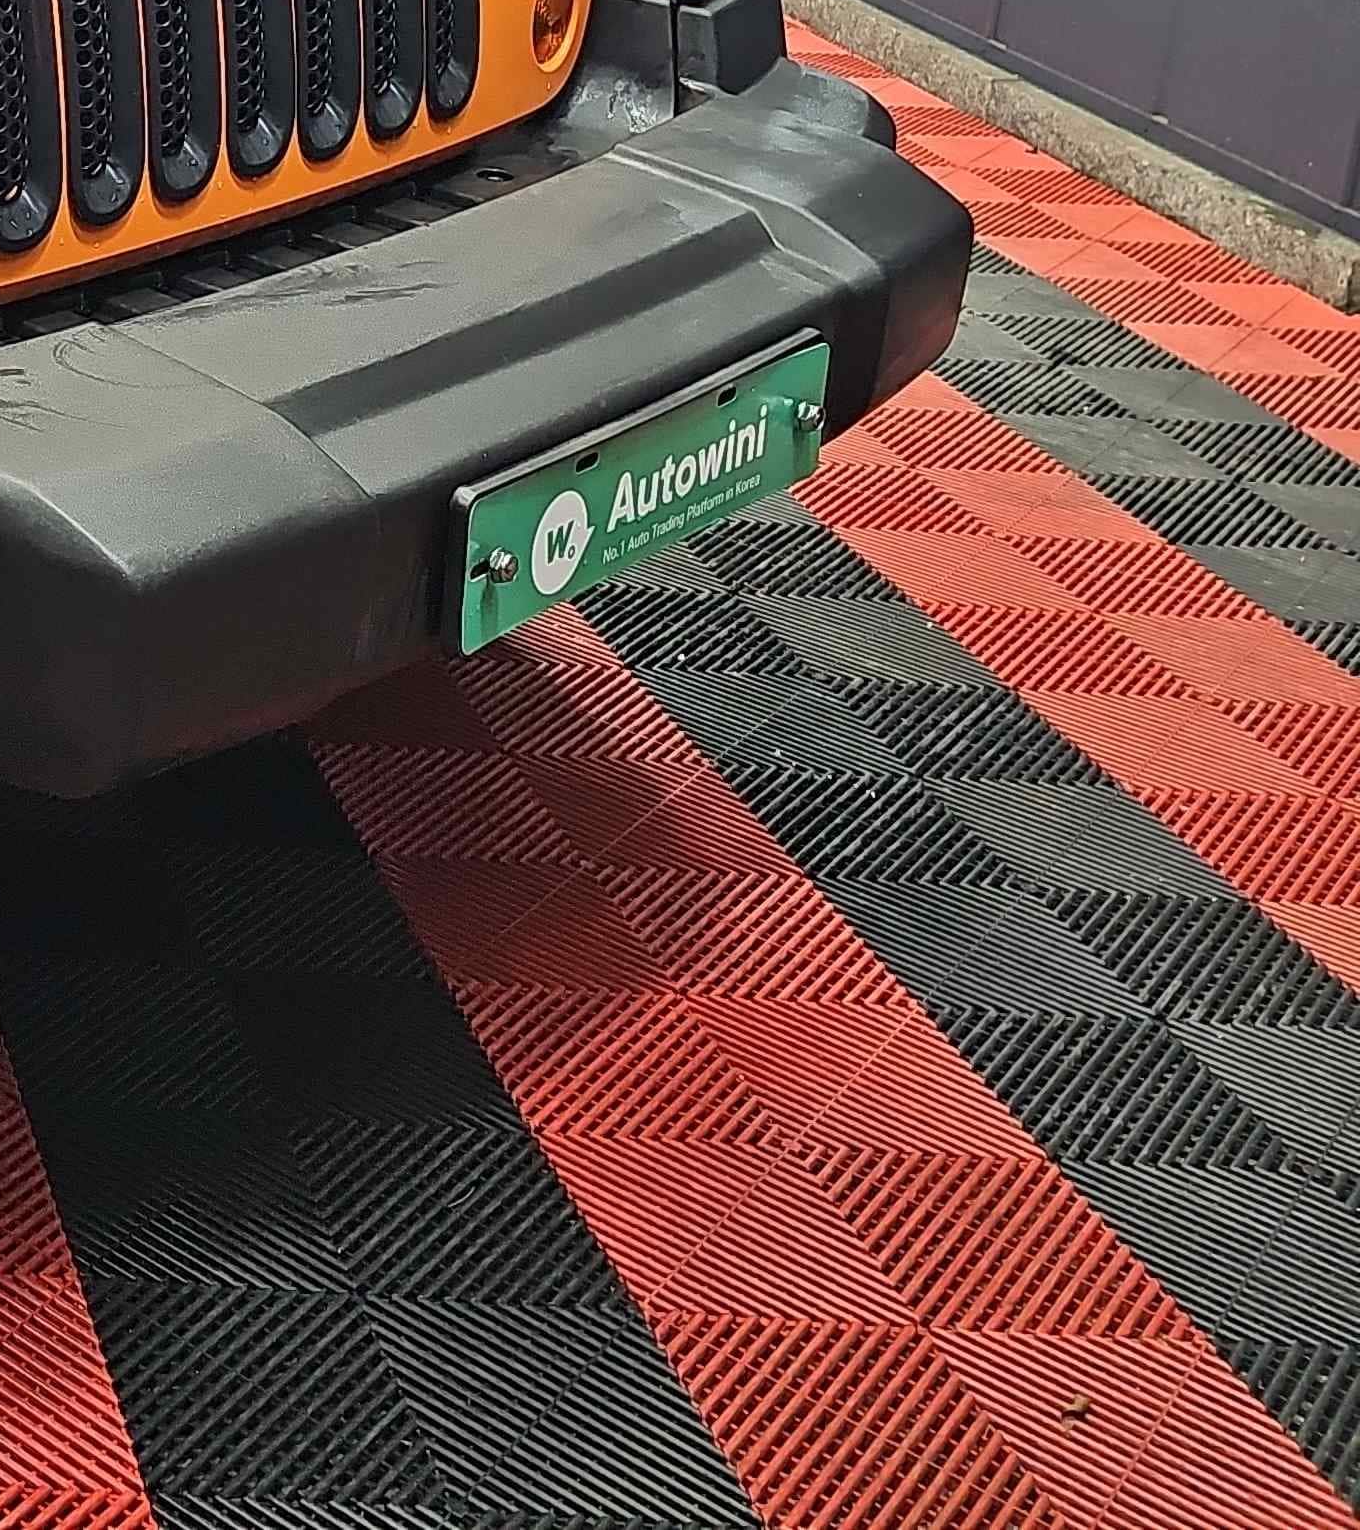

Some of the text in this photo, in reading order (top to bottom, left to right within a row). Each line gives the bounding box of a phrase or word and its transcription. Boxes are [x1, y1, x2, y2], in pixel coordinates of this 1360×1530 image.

[602, 474, 761, 565] No.1 Auto Trading Platform in Korea
[606, 404, 769, 534] Autowini
